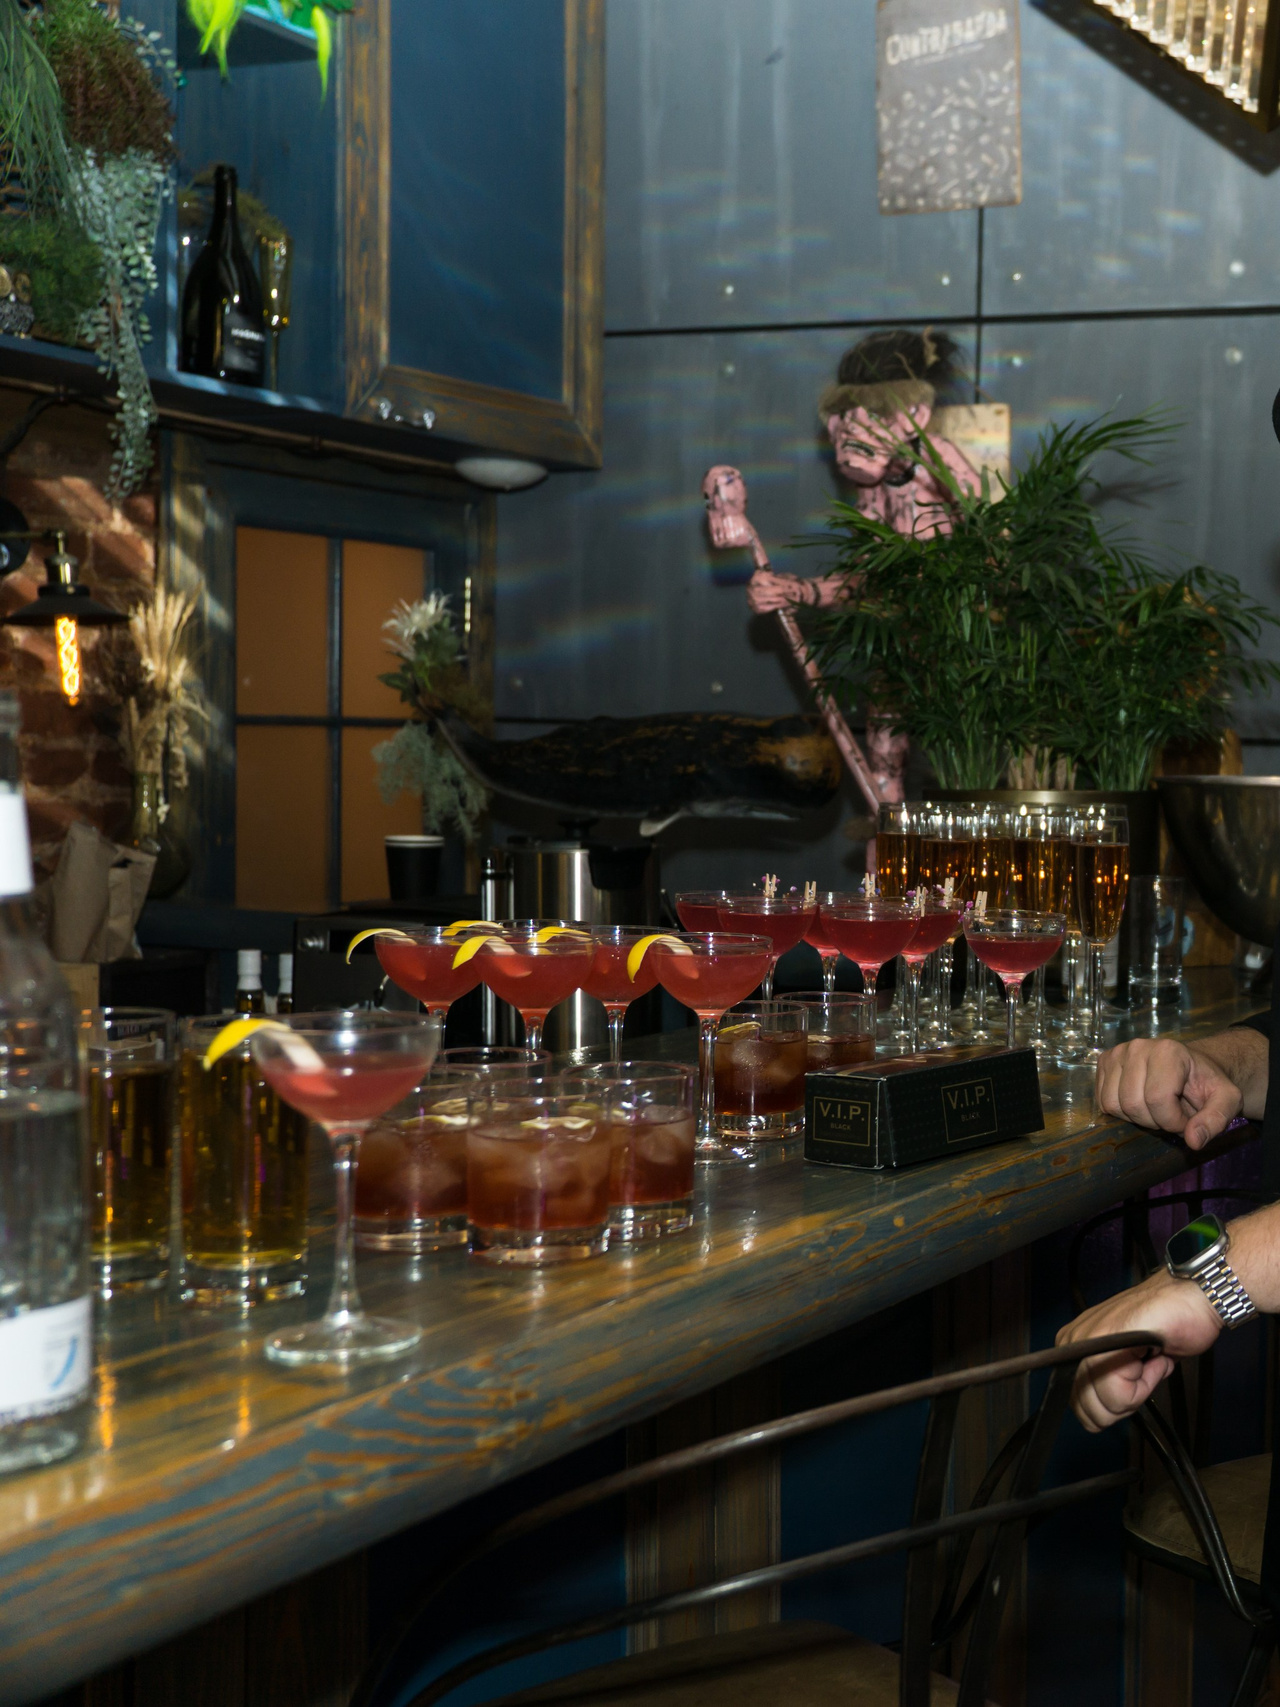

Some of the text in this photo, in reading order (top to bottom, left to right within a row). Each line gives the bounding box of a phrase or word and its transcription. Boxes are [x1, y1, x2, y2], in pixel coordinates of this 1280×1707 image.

[947, 1085, 990, 1110] V.I.P.
[819, 1101, 865, 1122] V.I.P.
[960, 1111, 981, 1122] BLACK
[830, 1122, 851, 1131] BLACK
